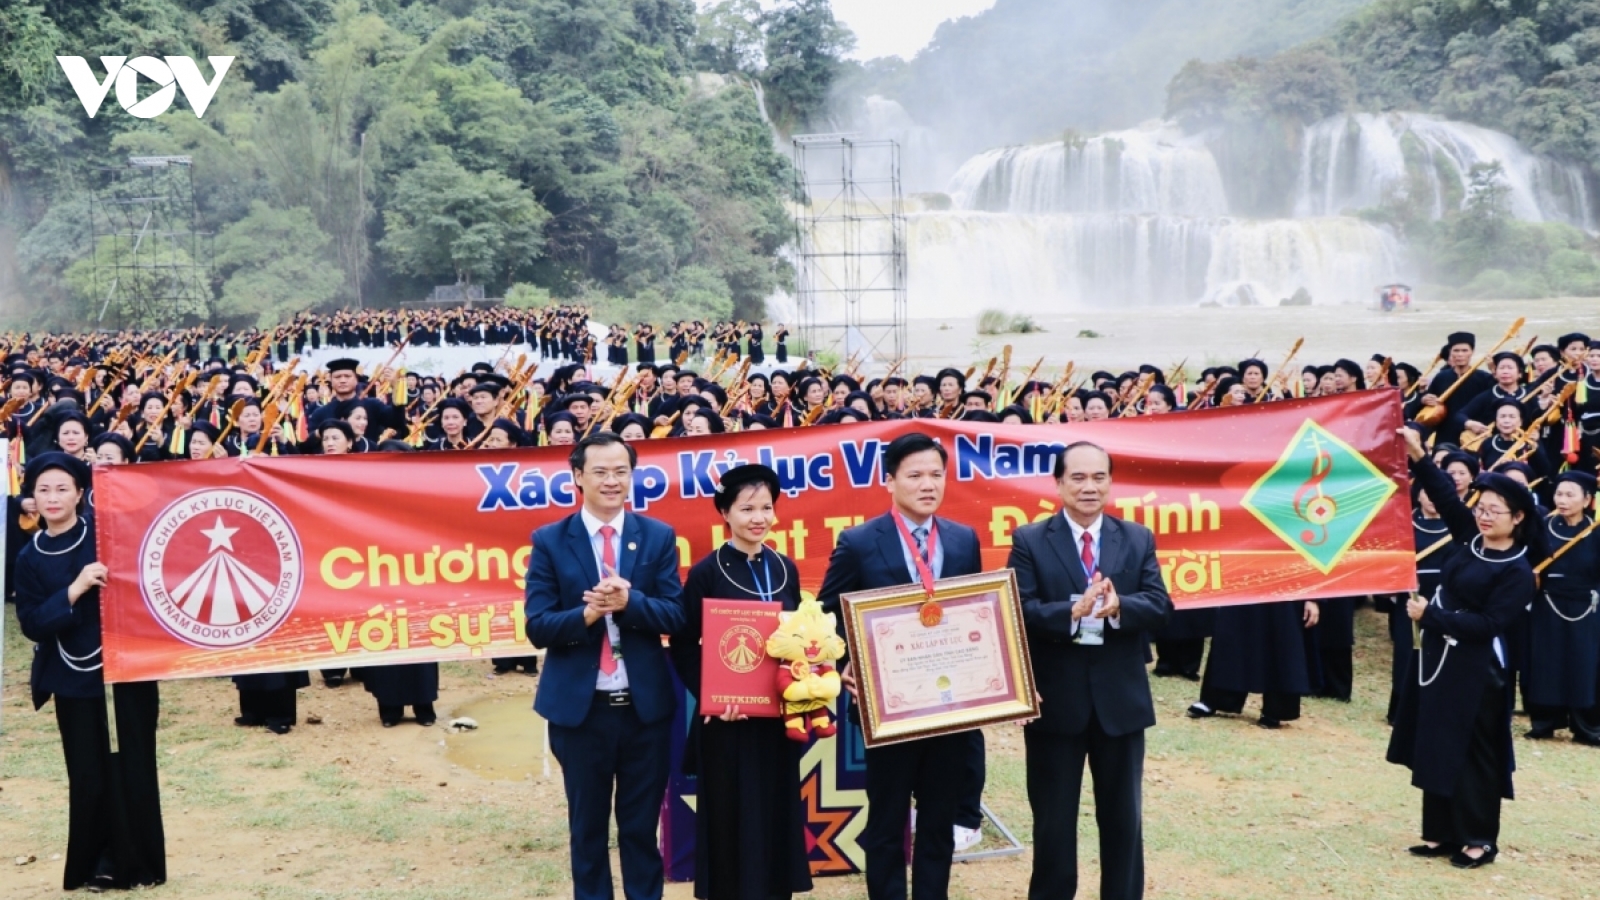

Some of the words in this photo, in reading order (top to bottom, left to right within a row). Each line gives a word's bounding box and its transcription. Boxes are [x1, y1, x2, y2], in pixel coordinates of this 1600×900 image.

[475, 462, 576, 512] Xác
[215, 497, 244, 510] LỤC
[274, 530, 293, 562] NAM
[151, 577, 190, 630] VIETNAM
[191, 624, 232, 639] BOOK
[235, 624, 252, 637] OF
[253, 571, 293, 629] RECORDS
[323, 604, 409, 654] với
[429, 605, 495, 656] sự
[711, 695, 772, 704] VIETKINGS
